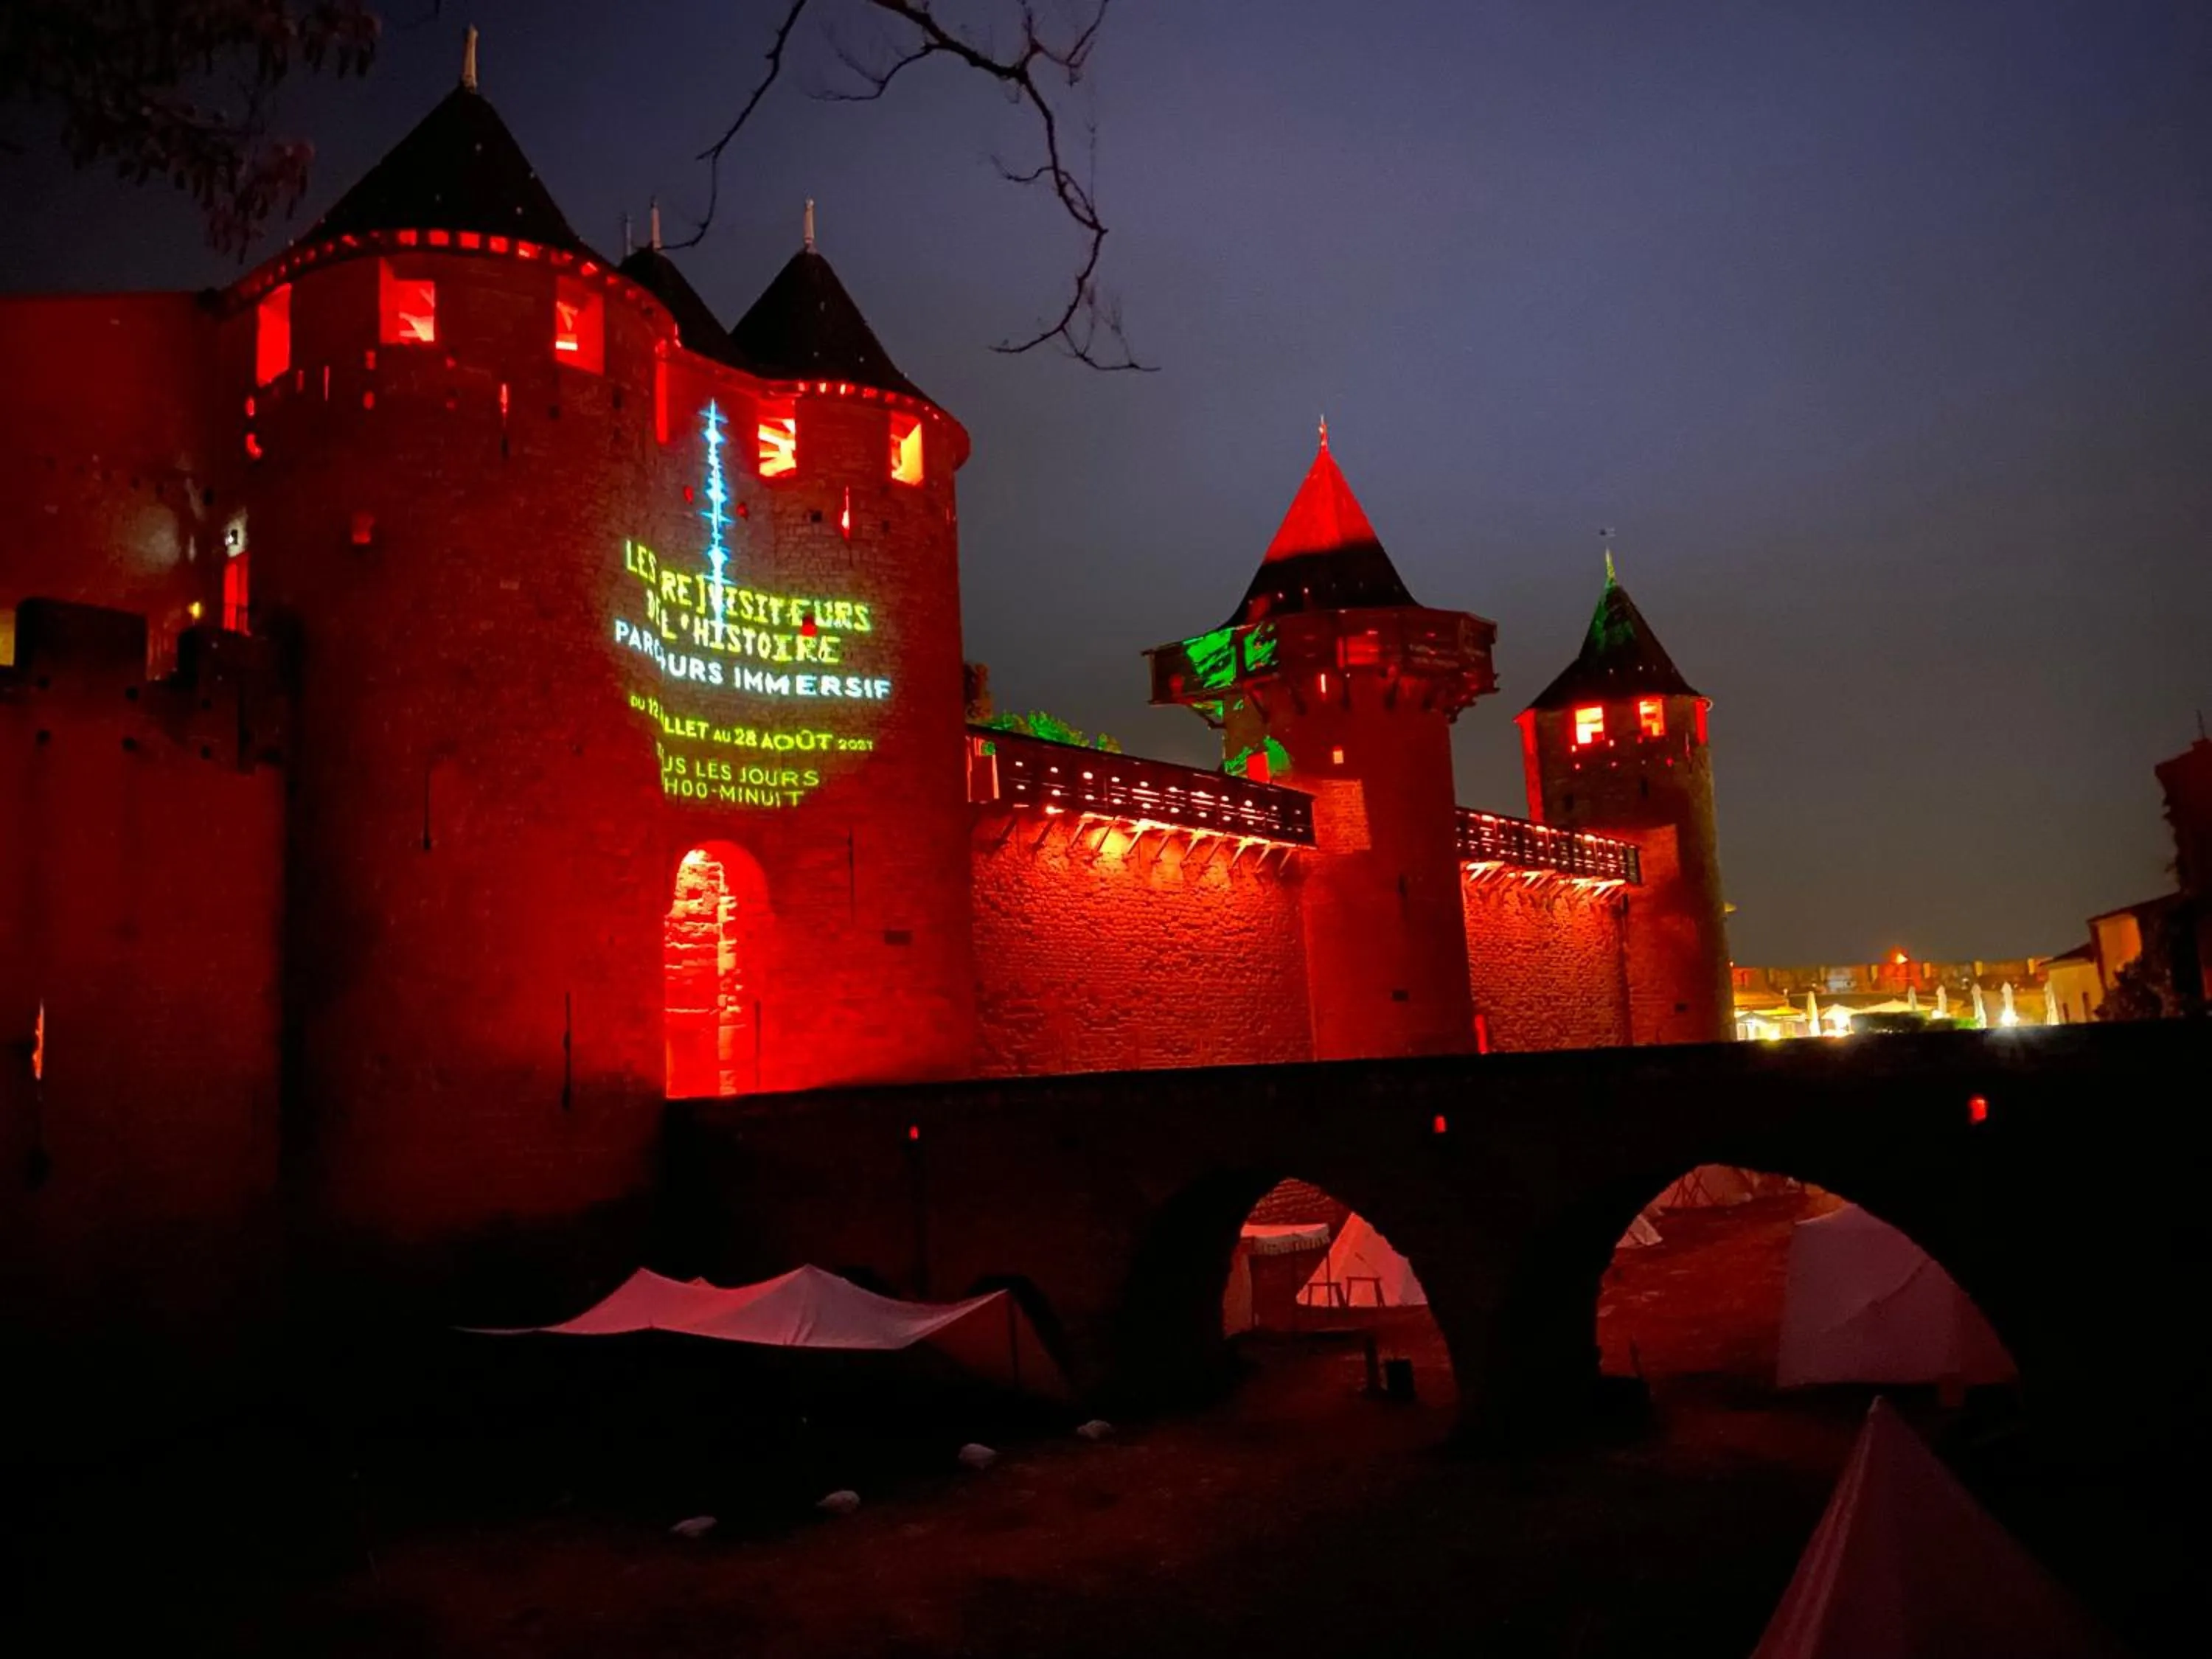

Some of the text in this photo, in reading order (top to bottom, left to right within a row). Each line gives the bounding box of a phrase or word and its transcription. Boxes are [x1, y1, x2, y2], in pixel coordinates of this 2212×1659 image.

[626, 540, 657, 584] LES
[614, 619, 891, 699] PARCURS IMMERSIF
[661, 608, 841, 664] L'HISTOIRE
[630, 695, 646, 711] DU
[713, 728, 731, 743] AU
[734, 727, 758, 747] 28
[760, 729, 834, 751] AOÛT
[696, 759, 732, 782] LES
[740, 765, 820, 787] JOURS
